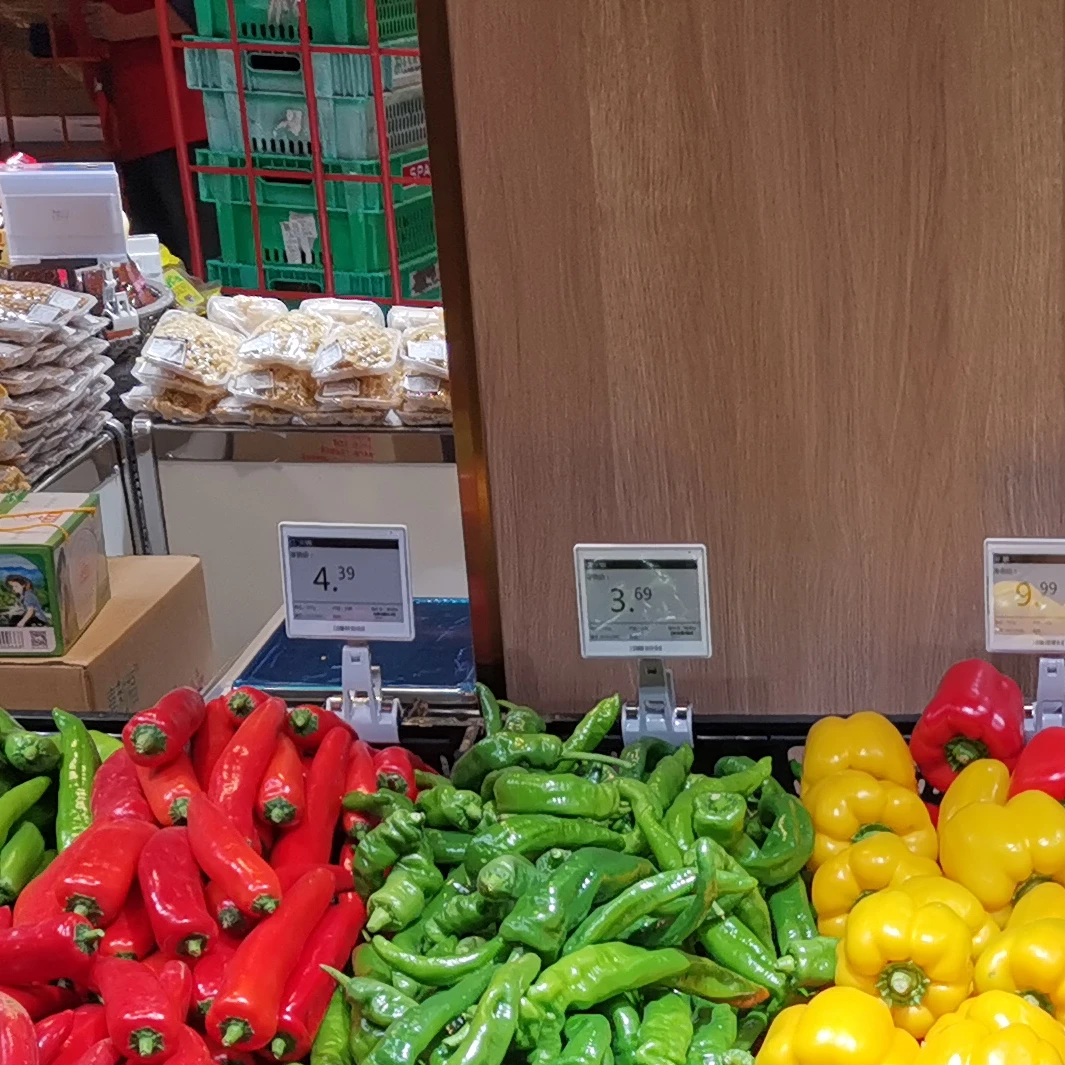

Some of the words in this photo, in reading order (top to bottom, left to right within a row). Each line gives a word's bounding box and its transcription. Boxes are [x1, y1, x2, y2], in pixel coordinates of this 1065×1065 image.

[312, 565, 356, 592] 4.39
[610, 586, 653, 613] 3.69
[1015, 581, 1058, 607] 9.99
